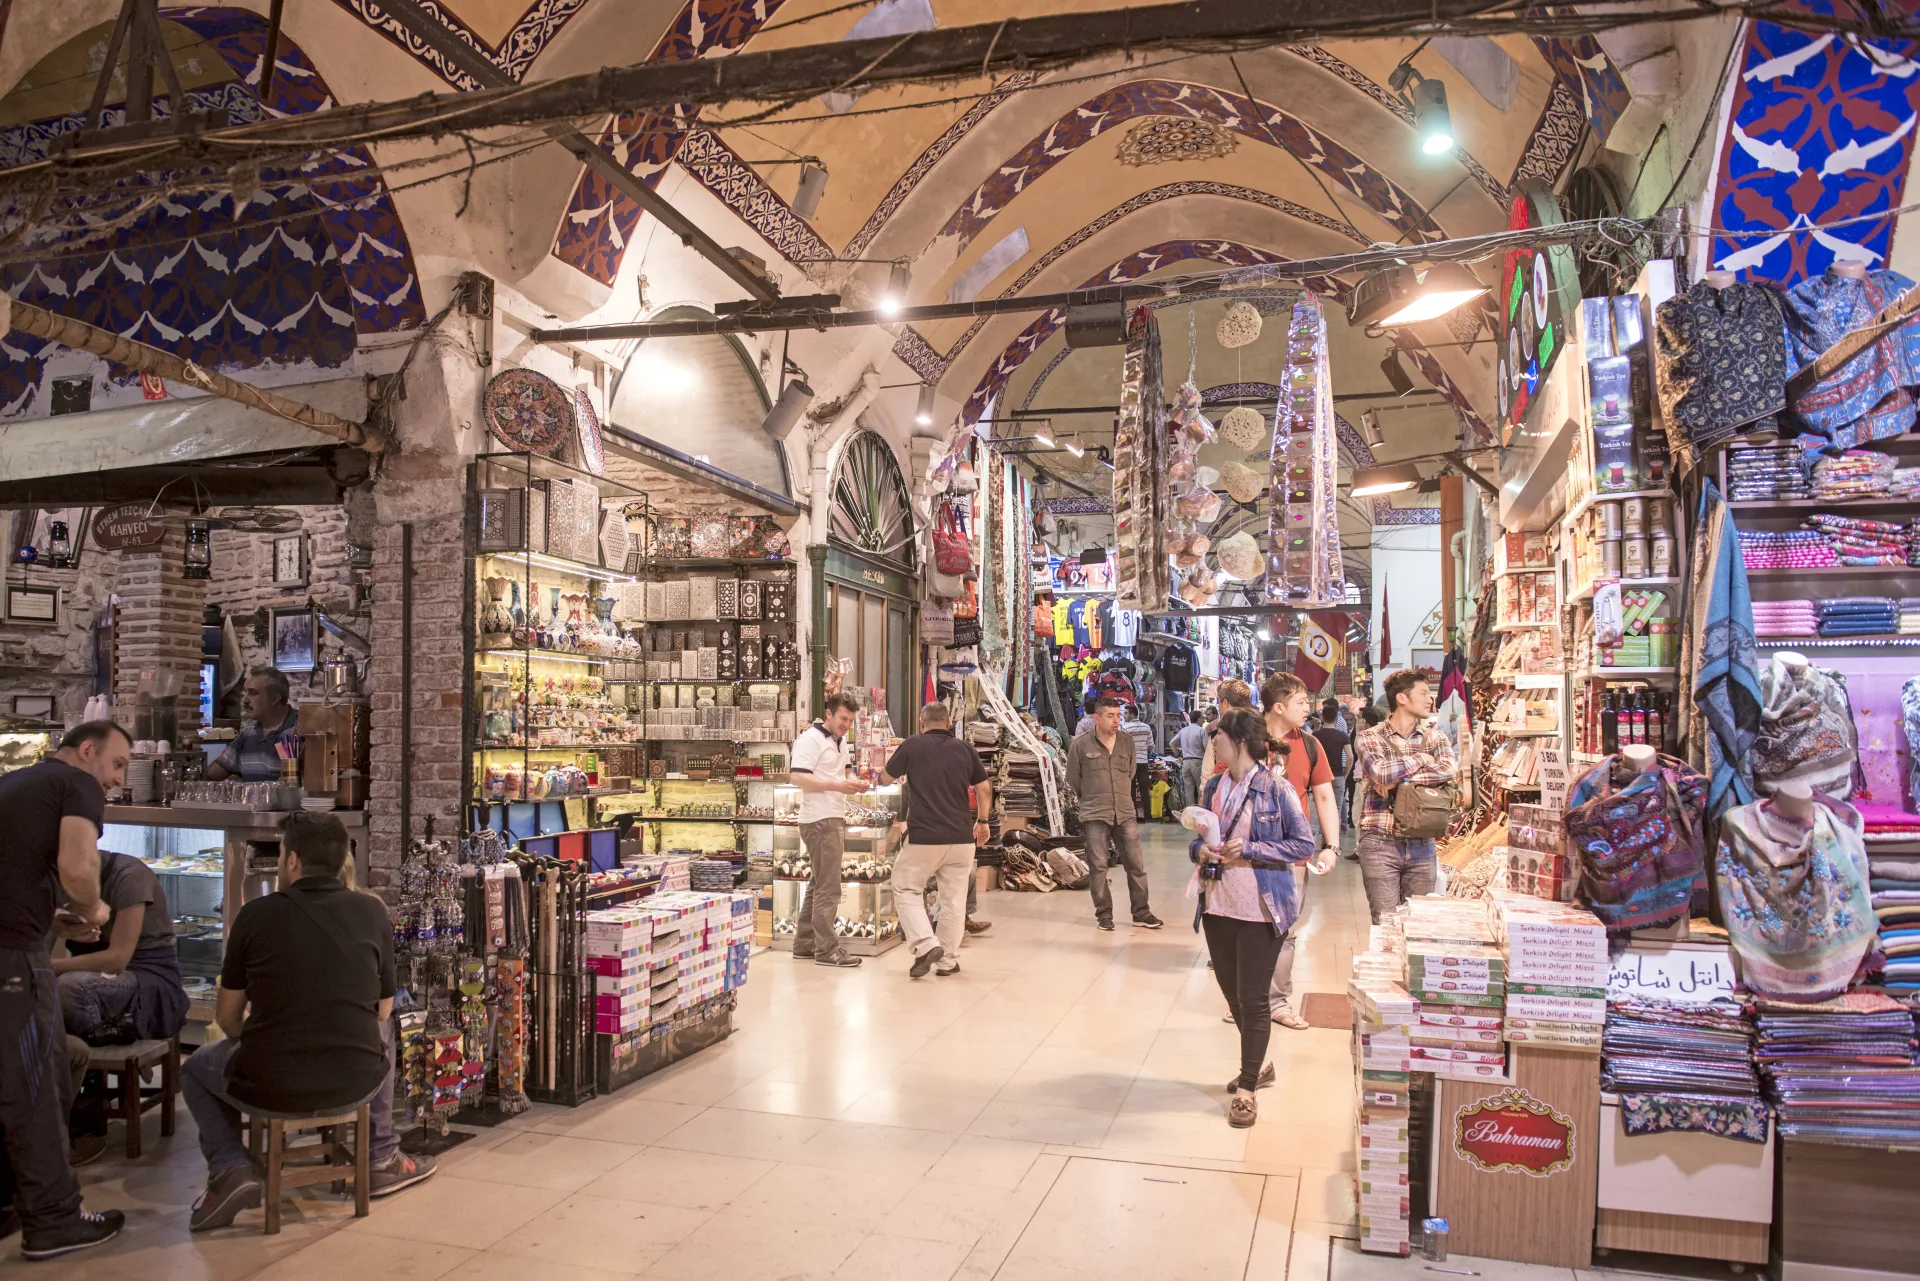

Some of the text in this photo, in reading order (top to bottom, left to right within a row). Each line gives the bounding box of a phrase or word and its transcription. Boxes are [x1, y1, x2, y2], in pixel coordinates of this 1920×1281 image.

[96, 510, 118, 534] ETHEM
[122, 536, 141, 546] 61-63
[1123, 612, 1130, 626] 8
[1541, 752, 1559, 763] 3 BOX
[1544, 768, 1564, 778] TURKISH
[1546, 782, 1565, 791] DELIGHT
[1550, 796, 1564, 809] 20 TL
[1521, 997, 1545, 1005] Turkish
[1571, 1024, 1598, 1033] Delight
[1570, 1036, 1596, 1045] Delight
[1465, 1120, 1564, 1149] Bahraman
